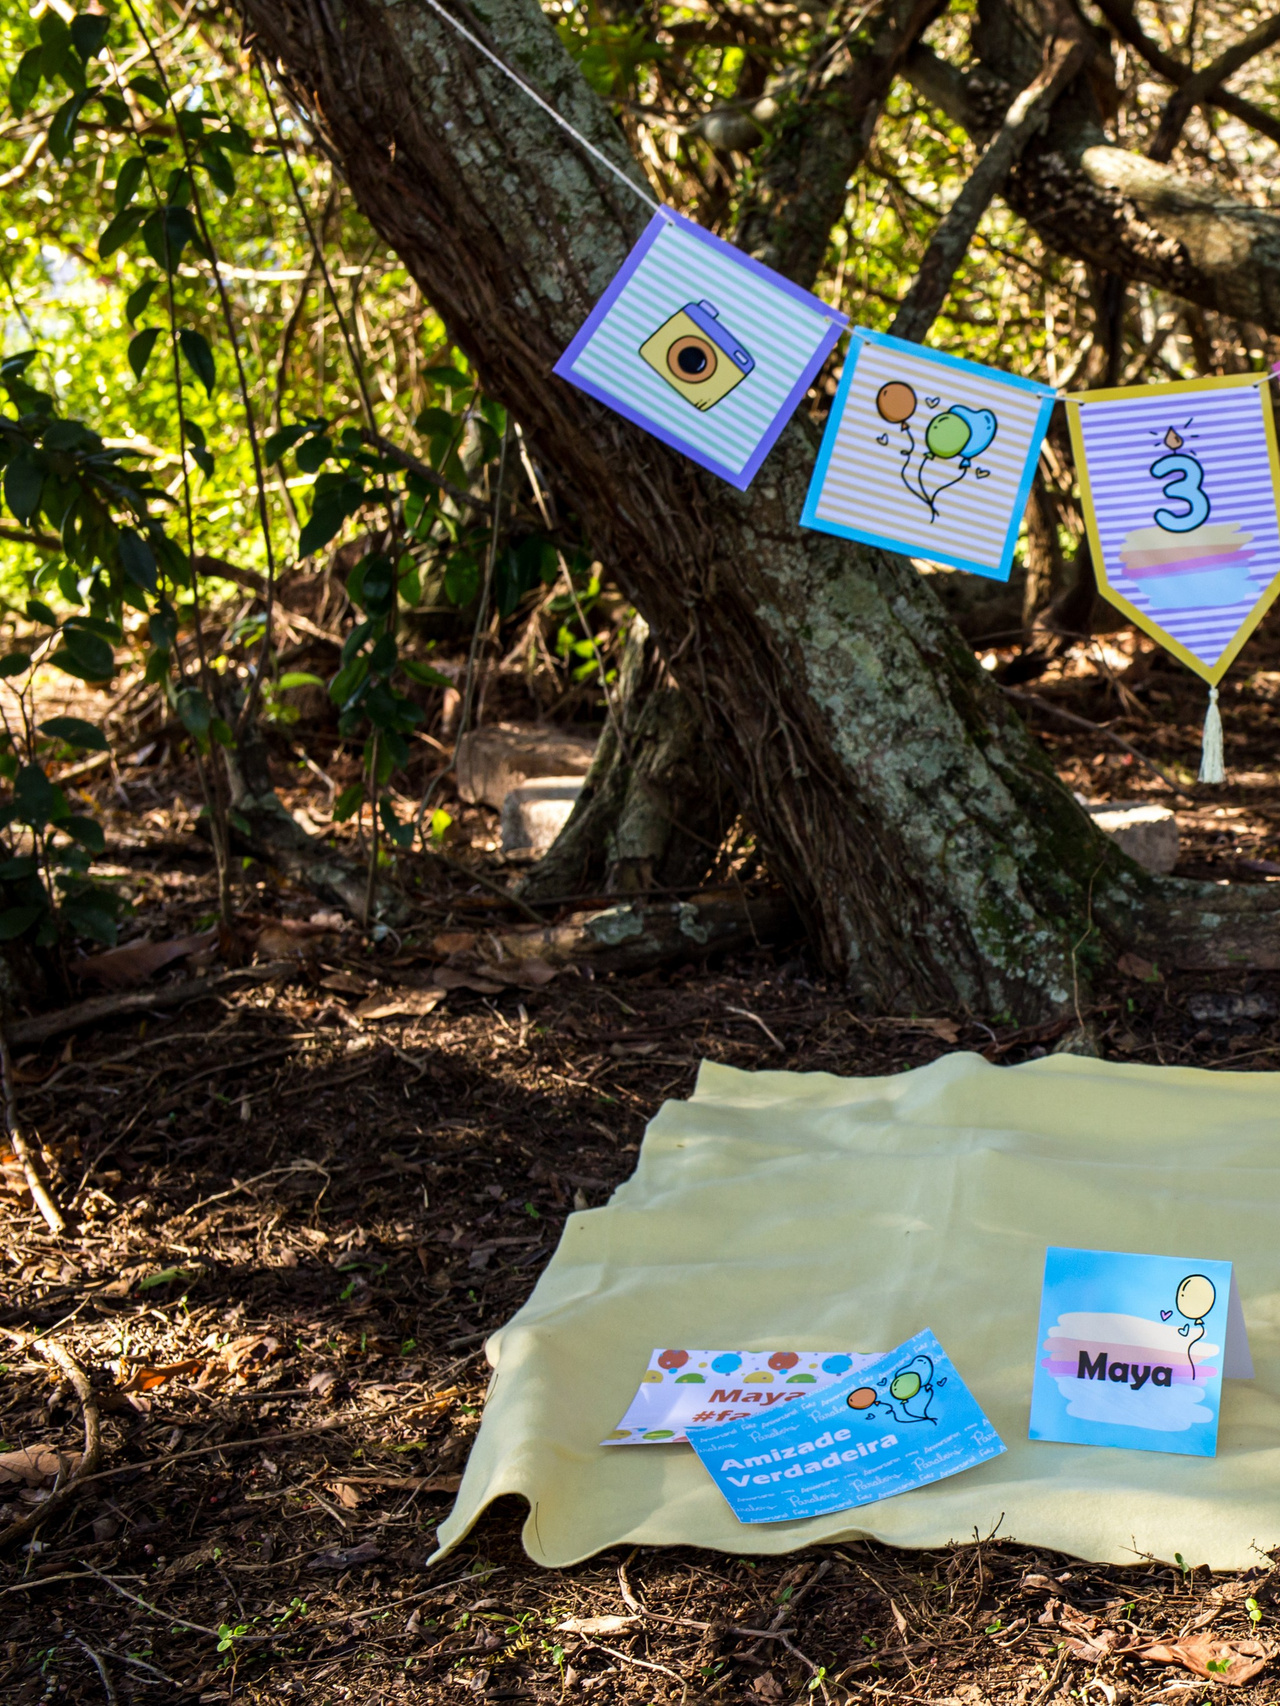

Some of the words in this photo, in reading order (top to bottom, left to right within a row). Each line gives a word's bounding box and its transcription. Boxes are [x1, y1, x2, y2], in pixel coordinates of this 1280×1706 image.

[1149, 454, 1211, 533] 3
[1077, 1350, 1173, 1391] Maya
[708, 1388, 806, 1406] Maya
[720, 1428, 852, 1471] Amizade
[726, 1434, 899, 1487] Verdadeira
